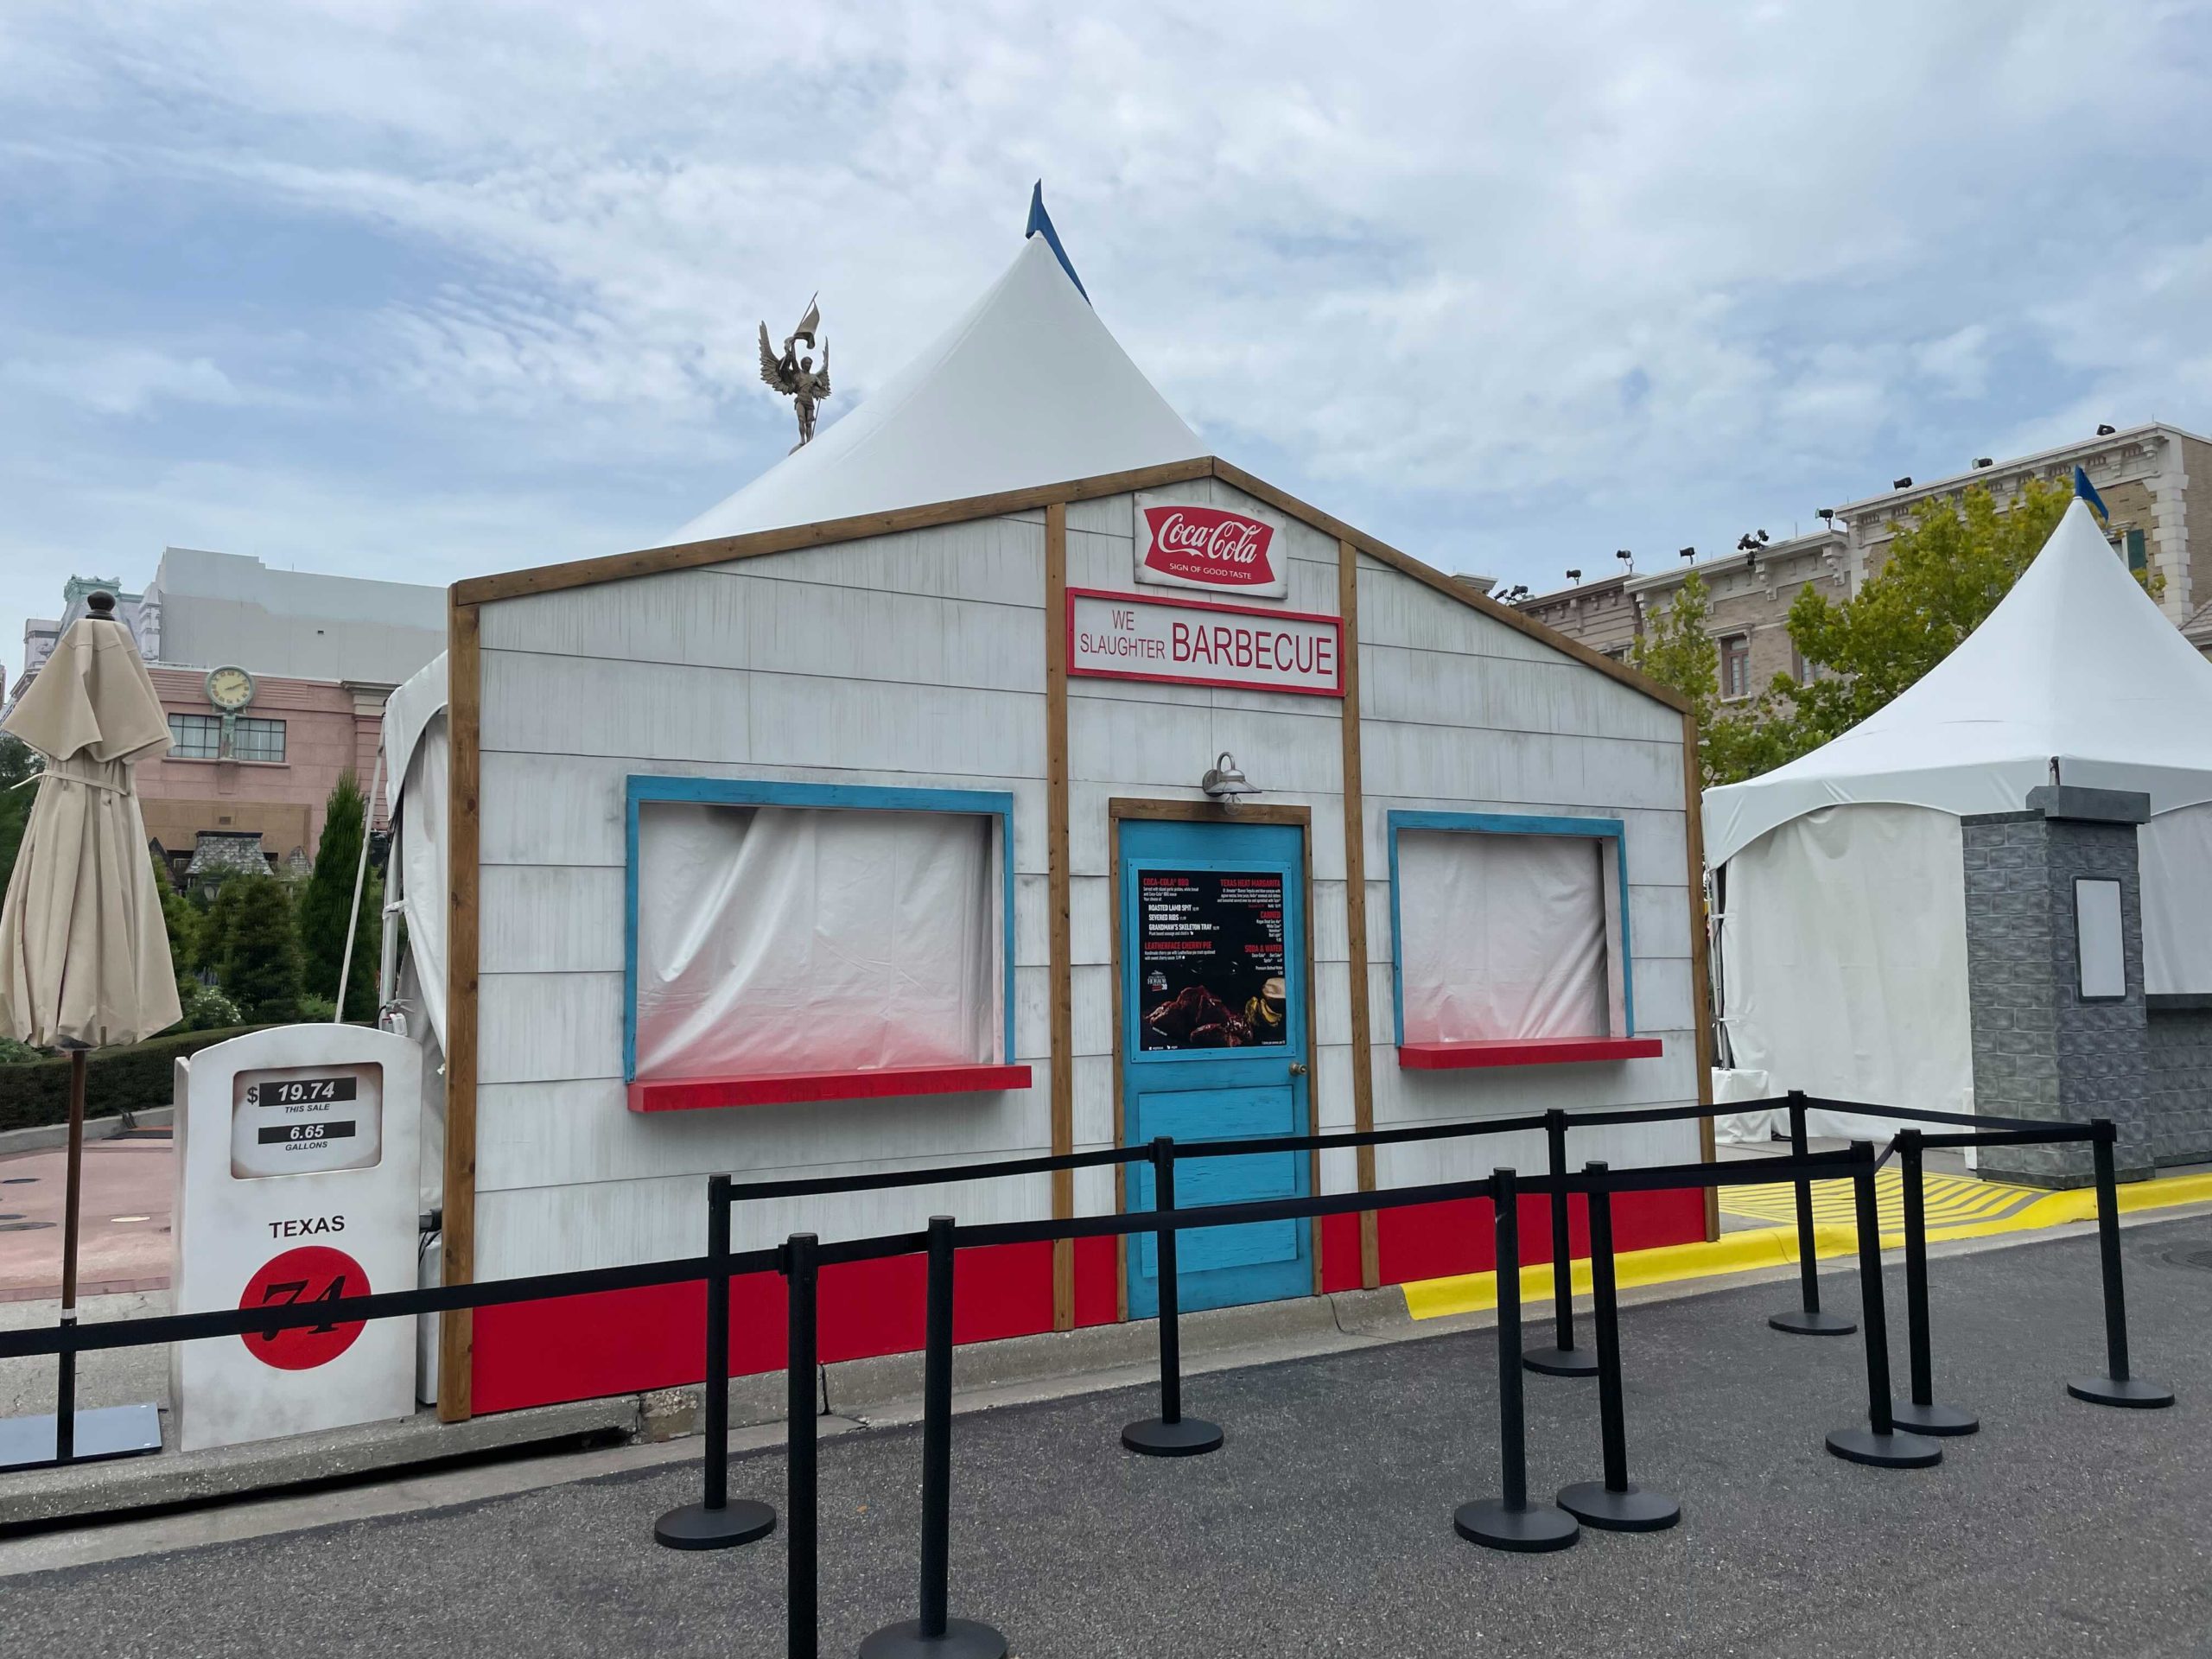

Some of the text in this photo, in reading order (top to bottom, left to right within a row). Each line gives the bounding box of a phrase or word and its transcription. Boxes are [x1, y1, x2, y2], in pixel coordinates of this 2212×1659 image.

[1157, 512, 1262, 563] Coca-Cola
[1169, 563, 1189, 572] SIGN
[1203, 567, 1228, 577] GOOD
[1229, 569, 1252, 580] TASTE
[1112, 609, 1135, 631] WE
[1079, 632, 1166, 659] SLAUGHTER
[1172, 622, 1332, 675] BARBECUE
[1181, 941, 1202, 950] CHERRY
[246, 1081, 335, 1105] $ 19.74
[284, 1103, 330, 1114] THIS SALE
[289, 1125, 325, 1140] 6.65
[285, 1141, 328, 1151] GALLONS
[269, 1215, 346, 1238] TEXAS
